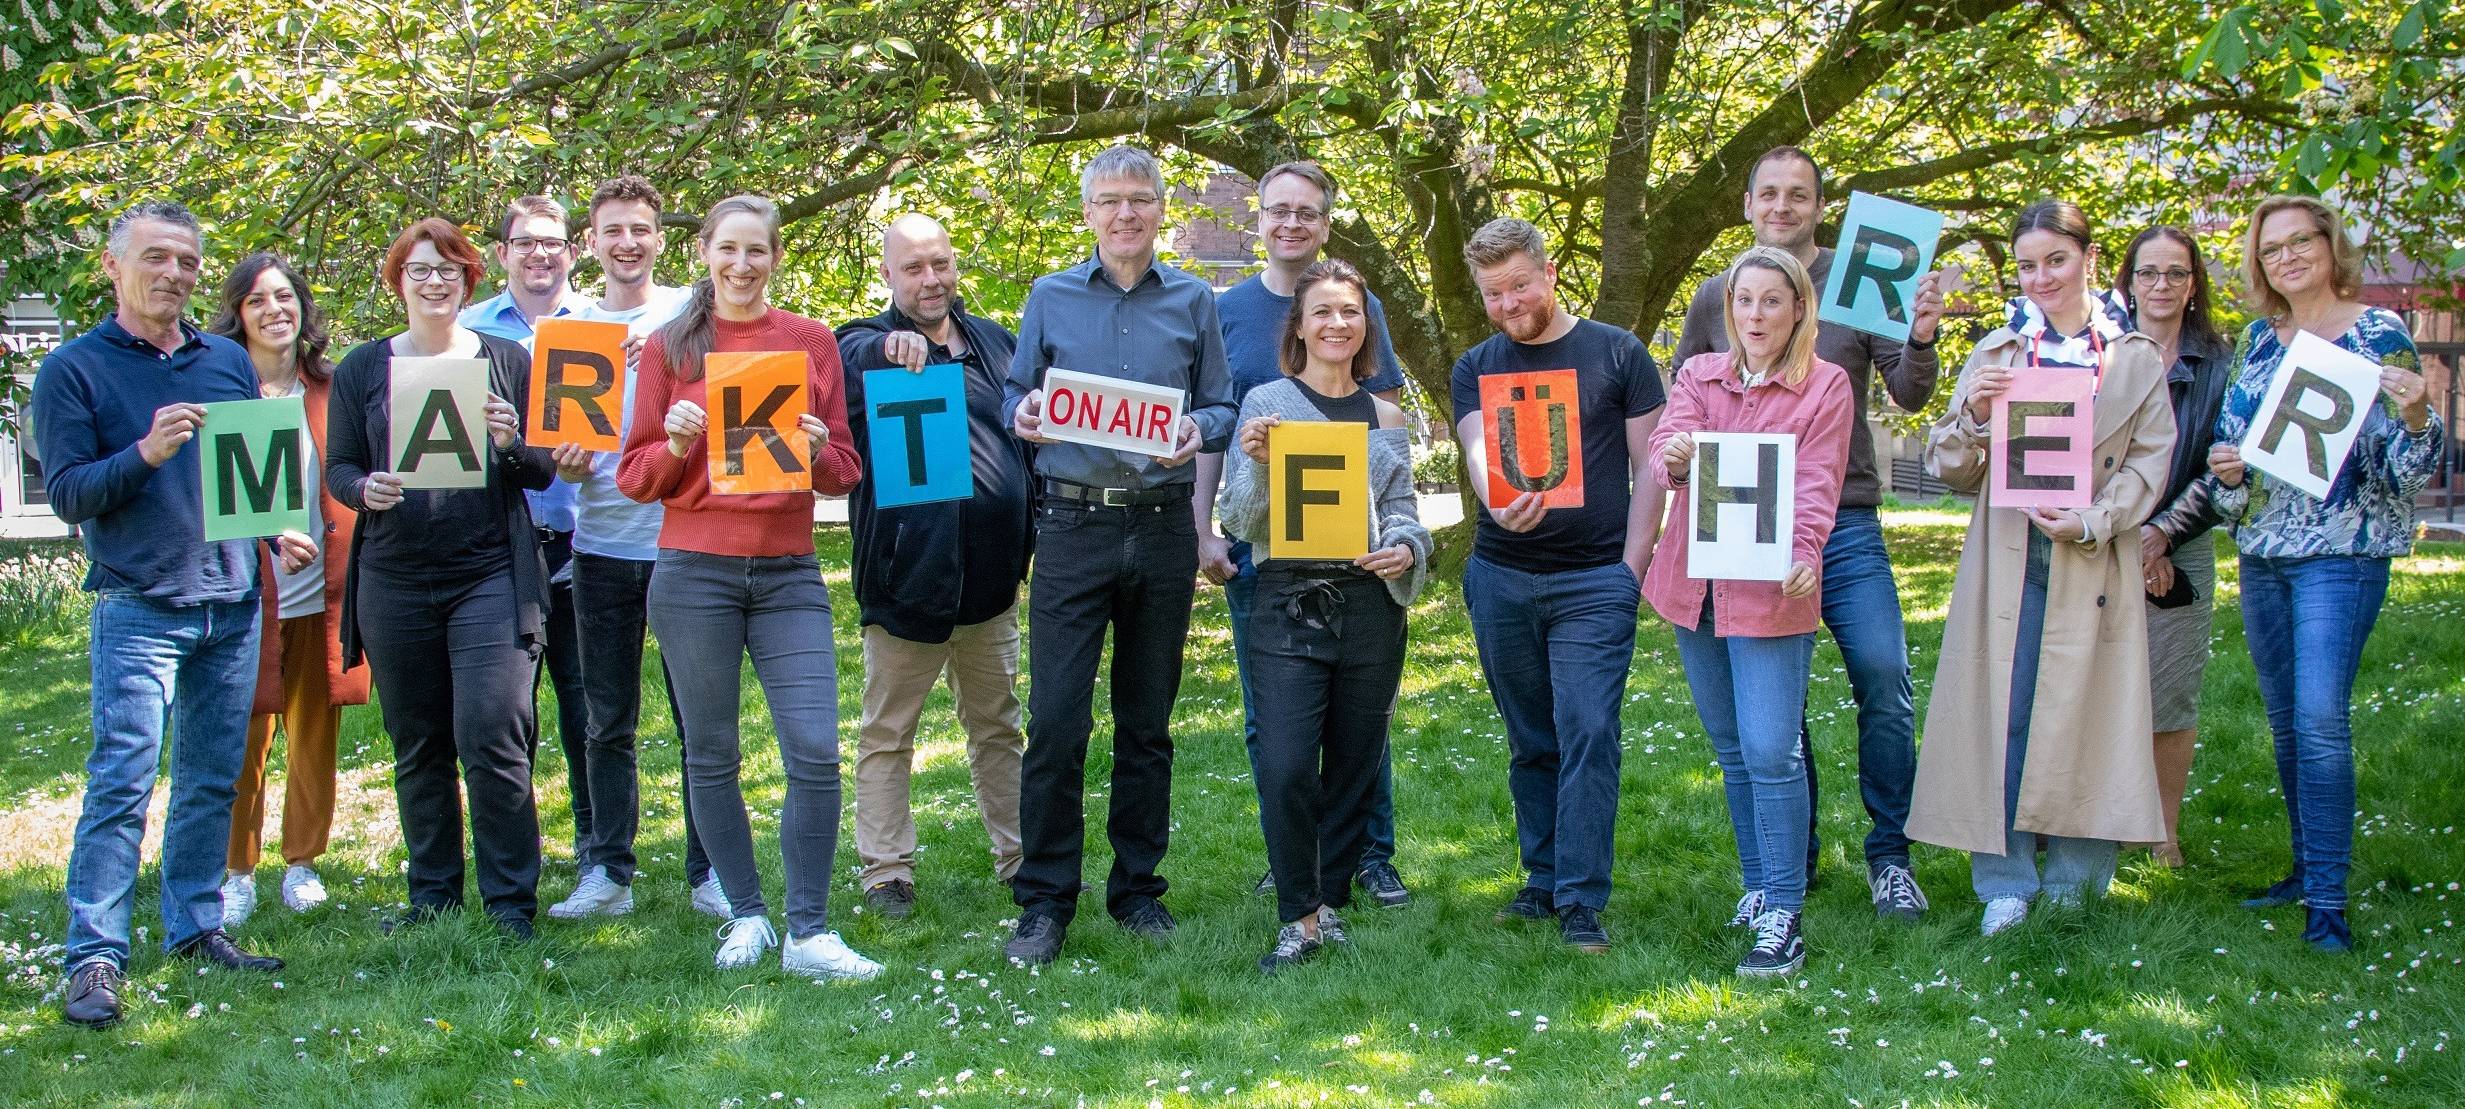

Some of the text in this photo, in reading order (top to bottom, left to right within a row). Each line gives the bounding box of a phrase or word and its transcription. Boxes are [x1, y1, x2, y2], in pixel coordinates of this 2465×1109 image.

[1835, 223, 1921, 325] R
[397, 388, 482, 473] A
[541, 348, 616, 437] R
[722, 384, 806, 477] K
[1048, 387, 1172, 443] ON AIR
[2257, 366, 2355, 482] R
[215, 427, 304, 516] M
[877, 397, 947, 487] T
[1497, 384, 1569, 493] Ü
[2005, 401, 2076, 491] E
[1284, 454, 1346, 542] F
[1696, 442, 1778, 544] H
